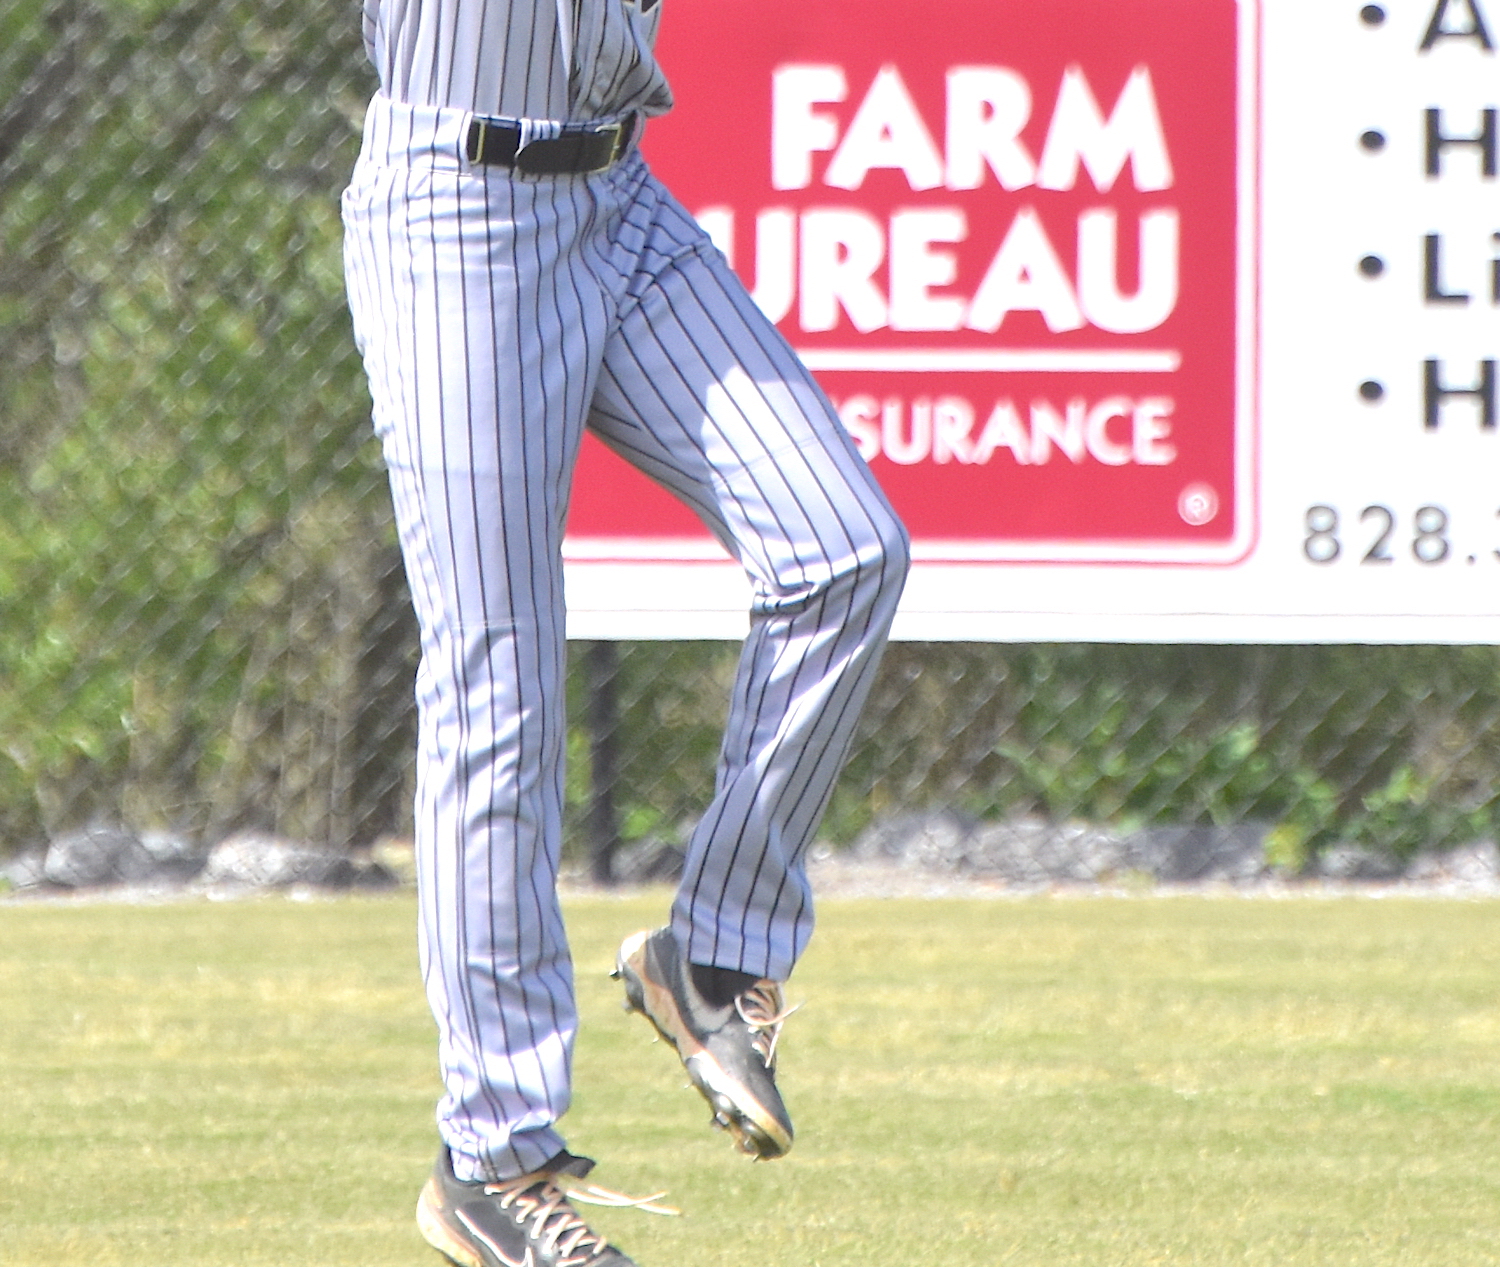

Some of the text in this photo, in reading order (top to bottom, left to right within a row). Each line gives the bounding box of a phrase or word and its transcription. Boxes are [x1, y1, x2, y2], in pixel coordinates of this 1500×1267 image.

[772, 63, 1174, 193] FARM
[834, 395, 1176, 466] SURANCE
[1303, 505, 1500, 563] 828.
